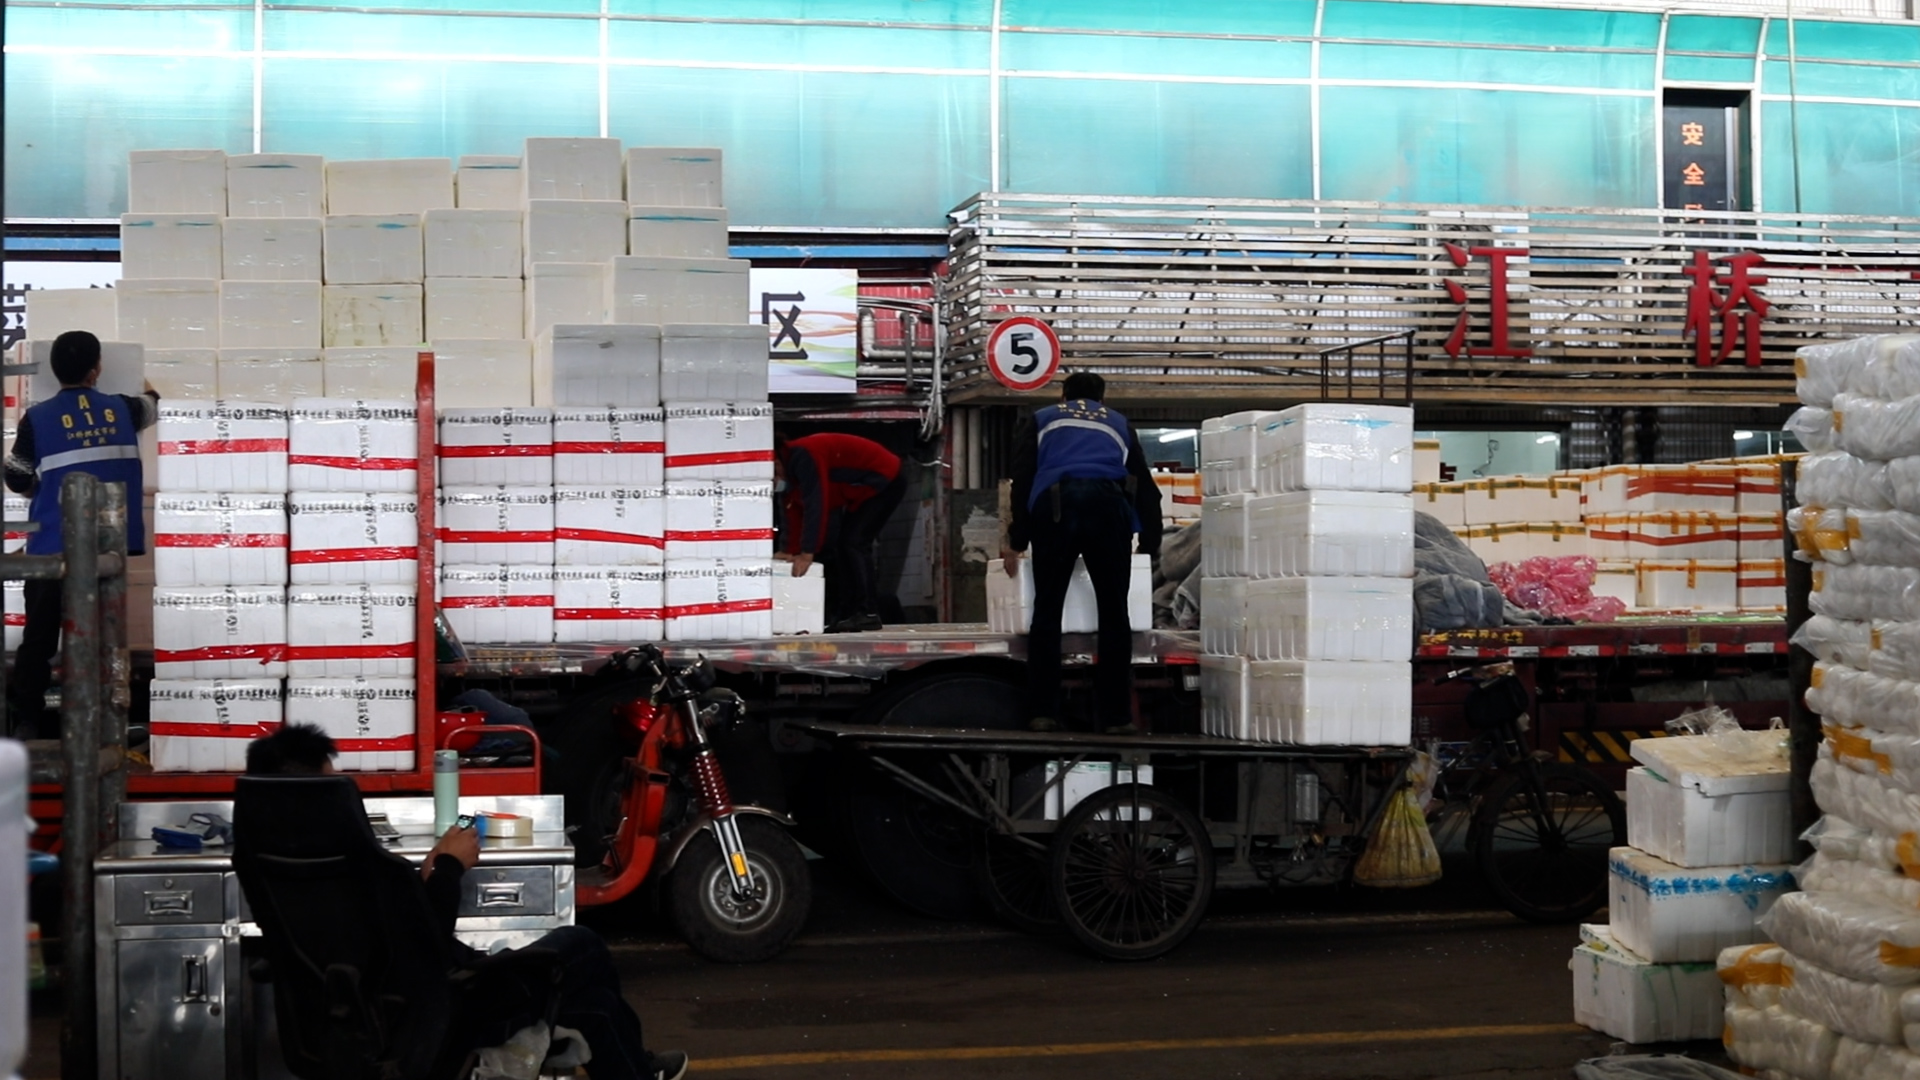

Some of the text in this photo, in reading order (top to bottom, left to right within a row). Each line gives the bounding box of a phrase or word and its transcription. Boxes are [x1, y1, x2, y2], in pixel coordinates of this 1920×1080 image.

[762, 291, 808, 360] 区
[1010, 332, 1040, 375] 5
[78, 394, 90, 409] A
